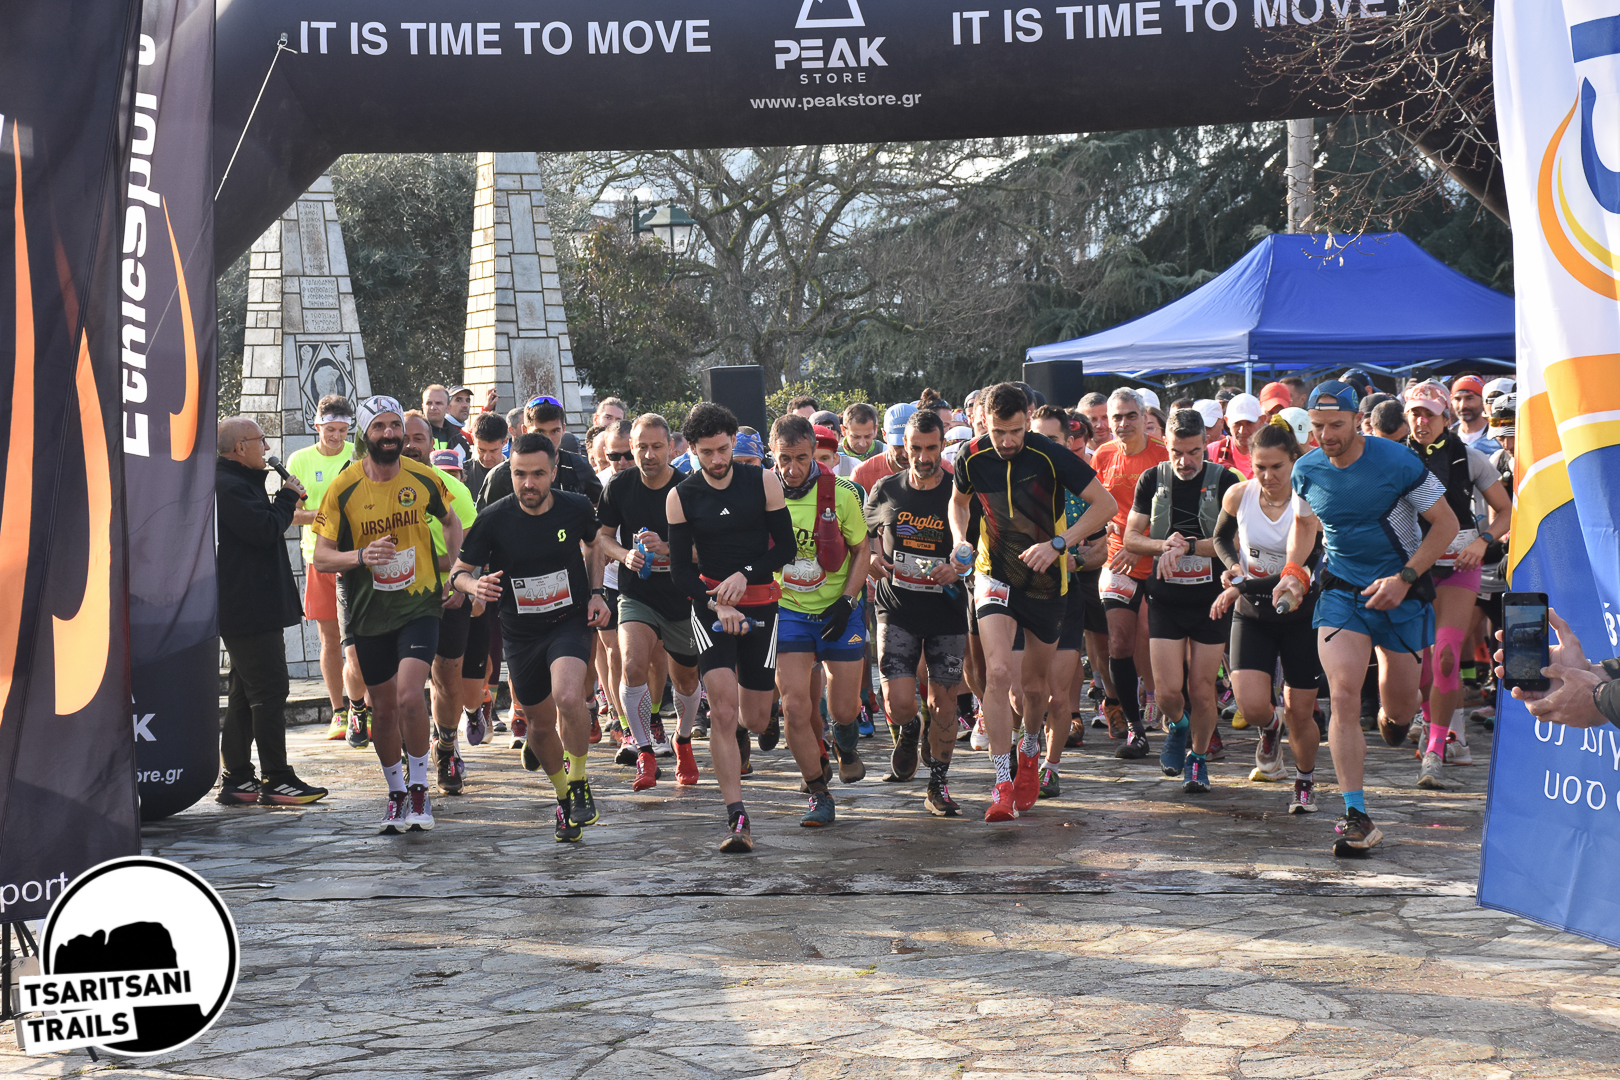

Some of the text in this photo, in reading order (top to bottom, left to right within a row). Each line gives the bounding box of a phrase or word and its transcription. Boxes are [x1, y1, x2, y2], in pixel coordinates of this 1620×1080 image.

[952, 10, 990, 45] IT
[1003, 7, 1043, 43] IS
[1055, 0, 1162, 40] TIME
[1175, 0, 1238, 32] TO
[300, 19, 711, 56] IT IS TIME TO MOVE
[774, 36, 889, 70] PEAK
[800, 72, 867, 85] STORE
[750, 93, 922, 111] www.peakstore.gr
[896, 511, 945, 530] Puglia
[379, 561, 410, 579] 386
[525, 582, 559, 602] 447
